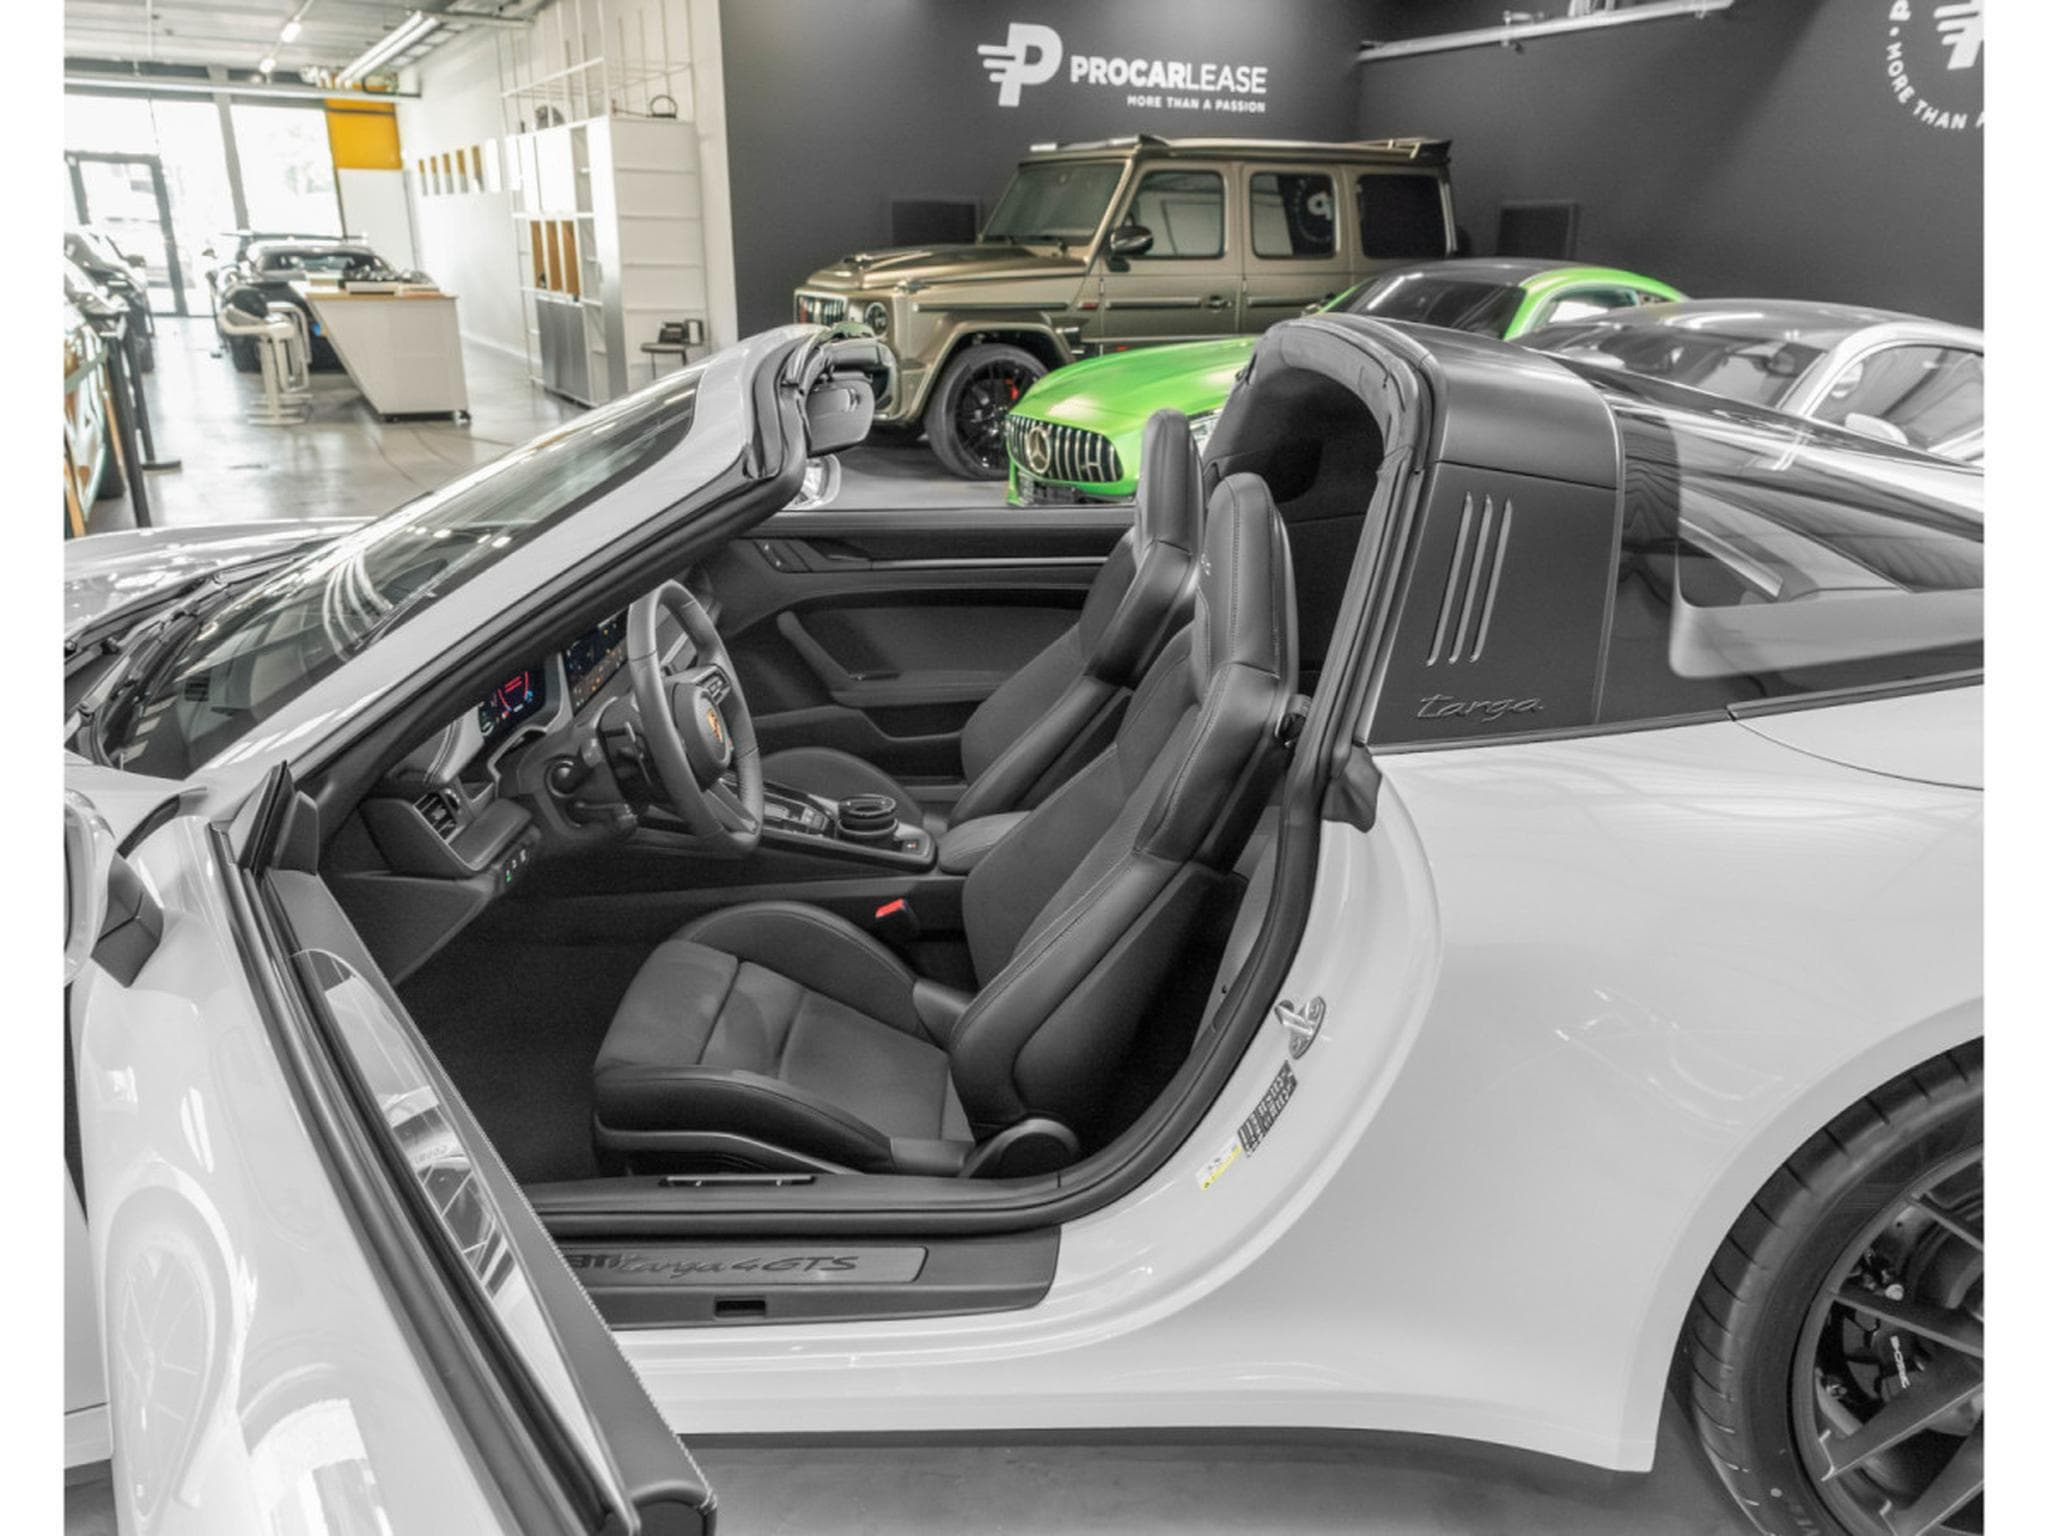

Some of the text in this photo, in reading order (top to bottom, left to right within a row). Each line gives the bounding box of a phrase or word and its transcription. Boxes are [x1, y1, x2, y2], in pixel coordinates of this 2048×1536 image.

[1070, 55, 1268, 94] PROCARLEASE
[1886, 41, 1915, 103] MORE
[1912, 99, 1968, 129] THAN
[1126, 95, 1267, 113] MORE THAN A PASSION
[1416, 693, 1544, 723] targa
